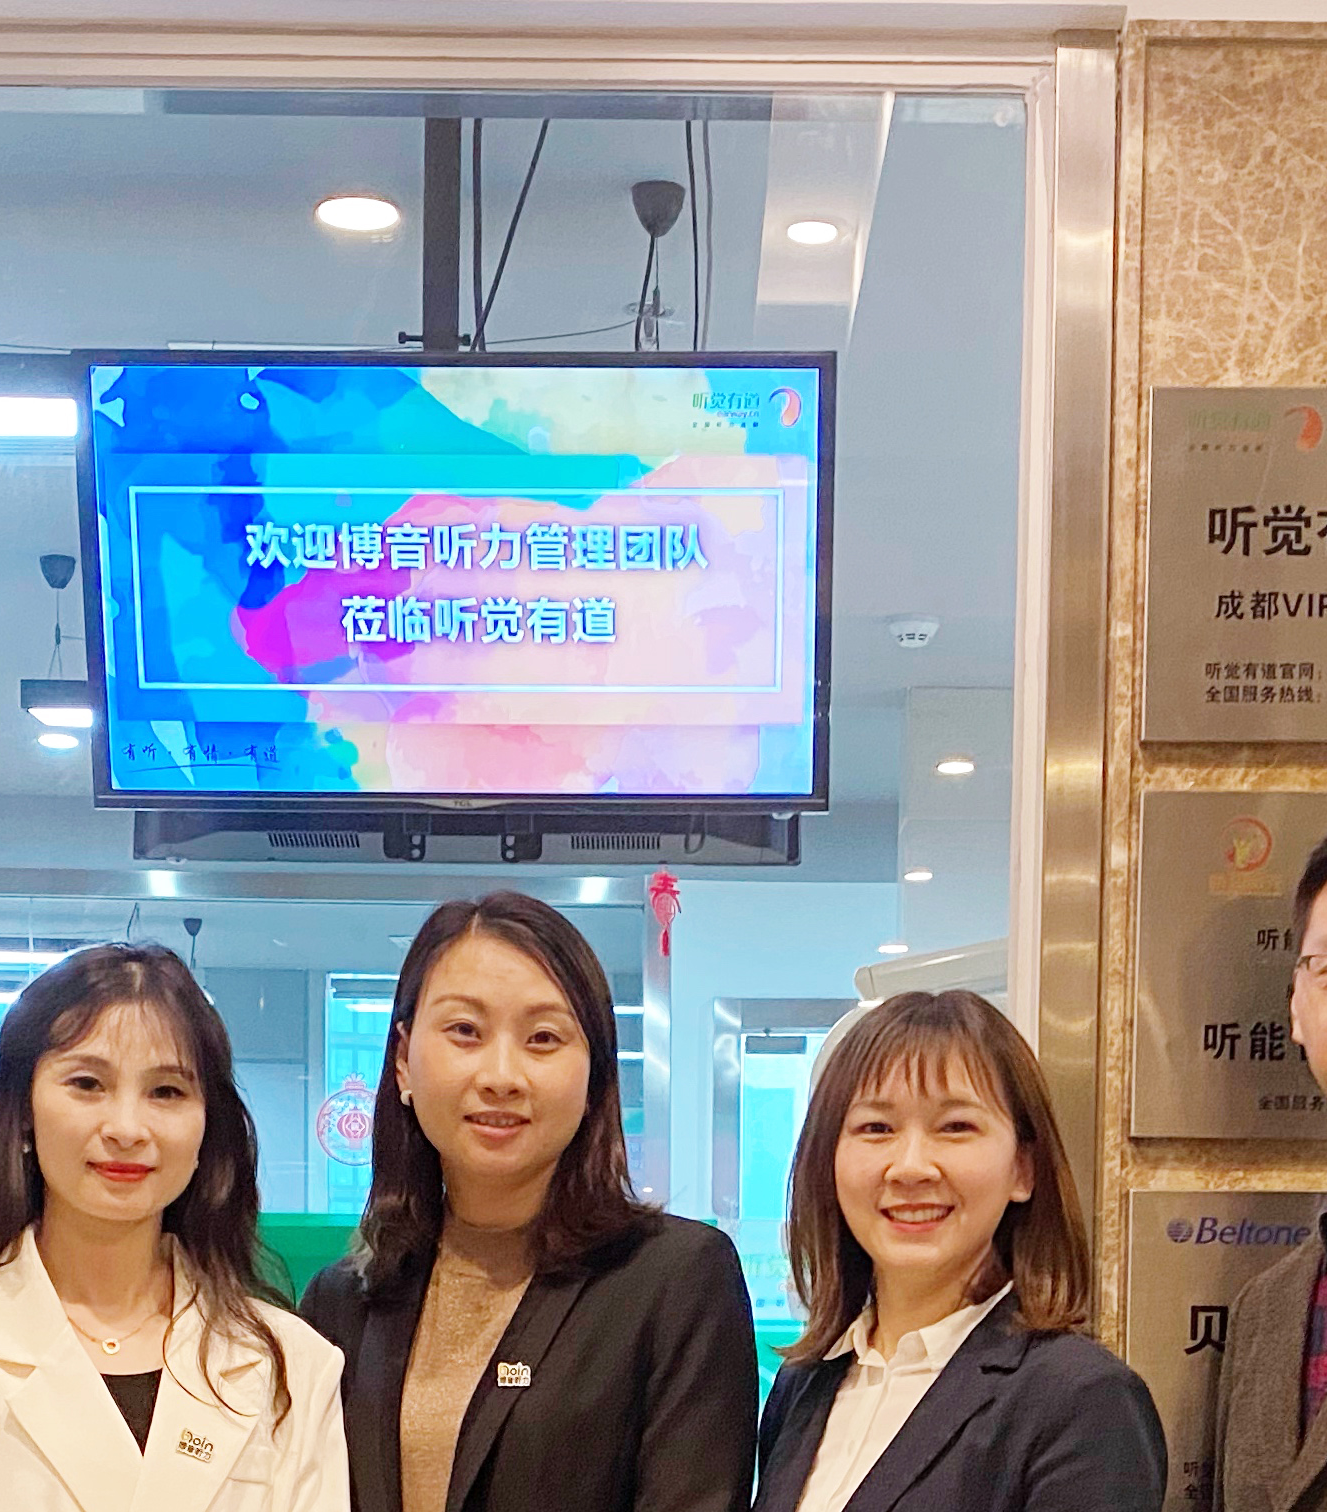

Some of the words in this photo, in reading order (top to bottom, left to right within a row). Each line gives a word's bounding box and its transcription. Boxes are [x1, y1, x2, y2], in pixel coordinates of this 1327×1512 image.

[692, 392, 760, 409] 听觉有道
[245, 522, 708, 571] 欢迎博音听力管理团队
[340, 597, 617, 645] 莅临听觉有道
[1204, 1021, 1307, 1061] 听能
[1195, 1217, 1310, 1245] Beltone
